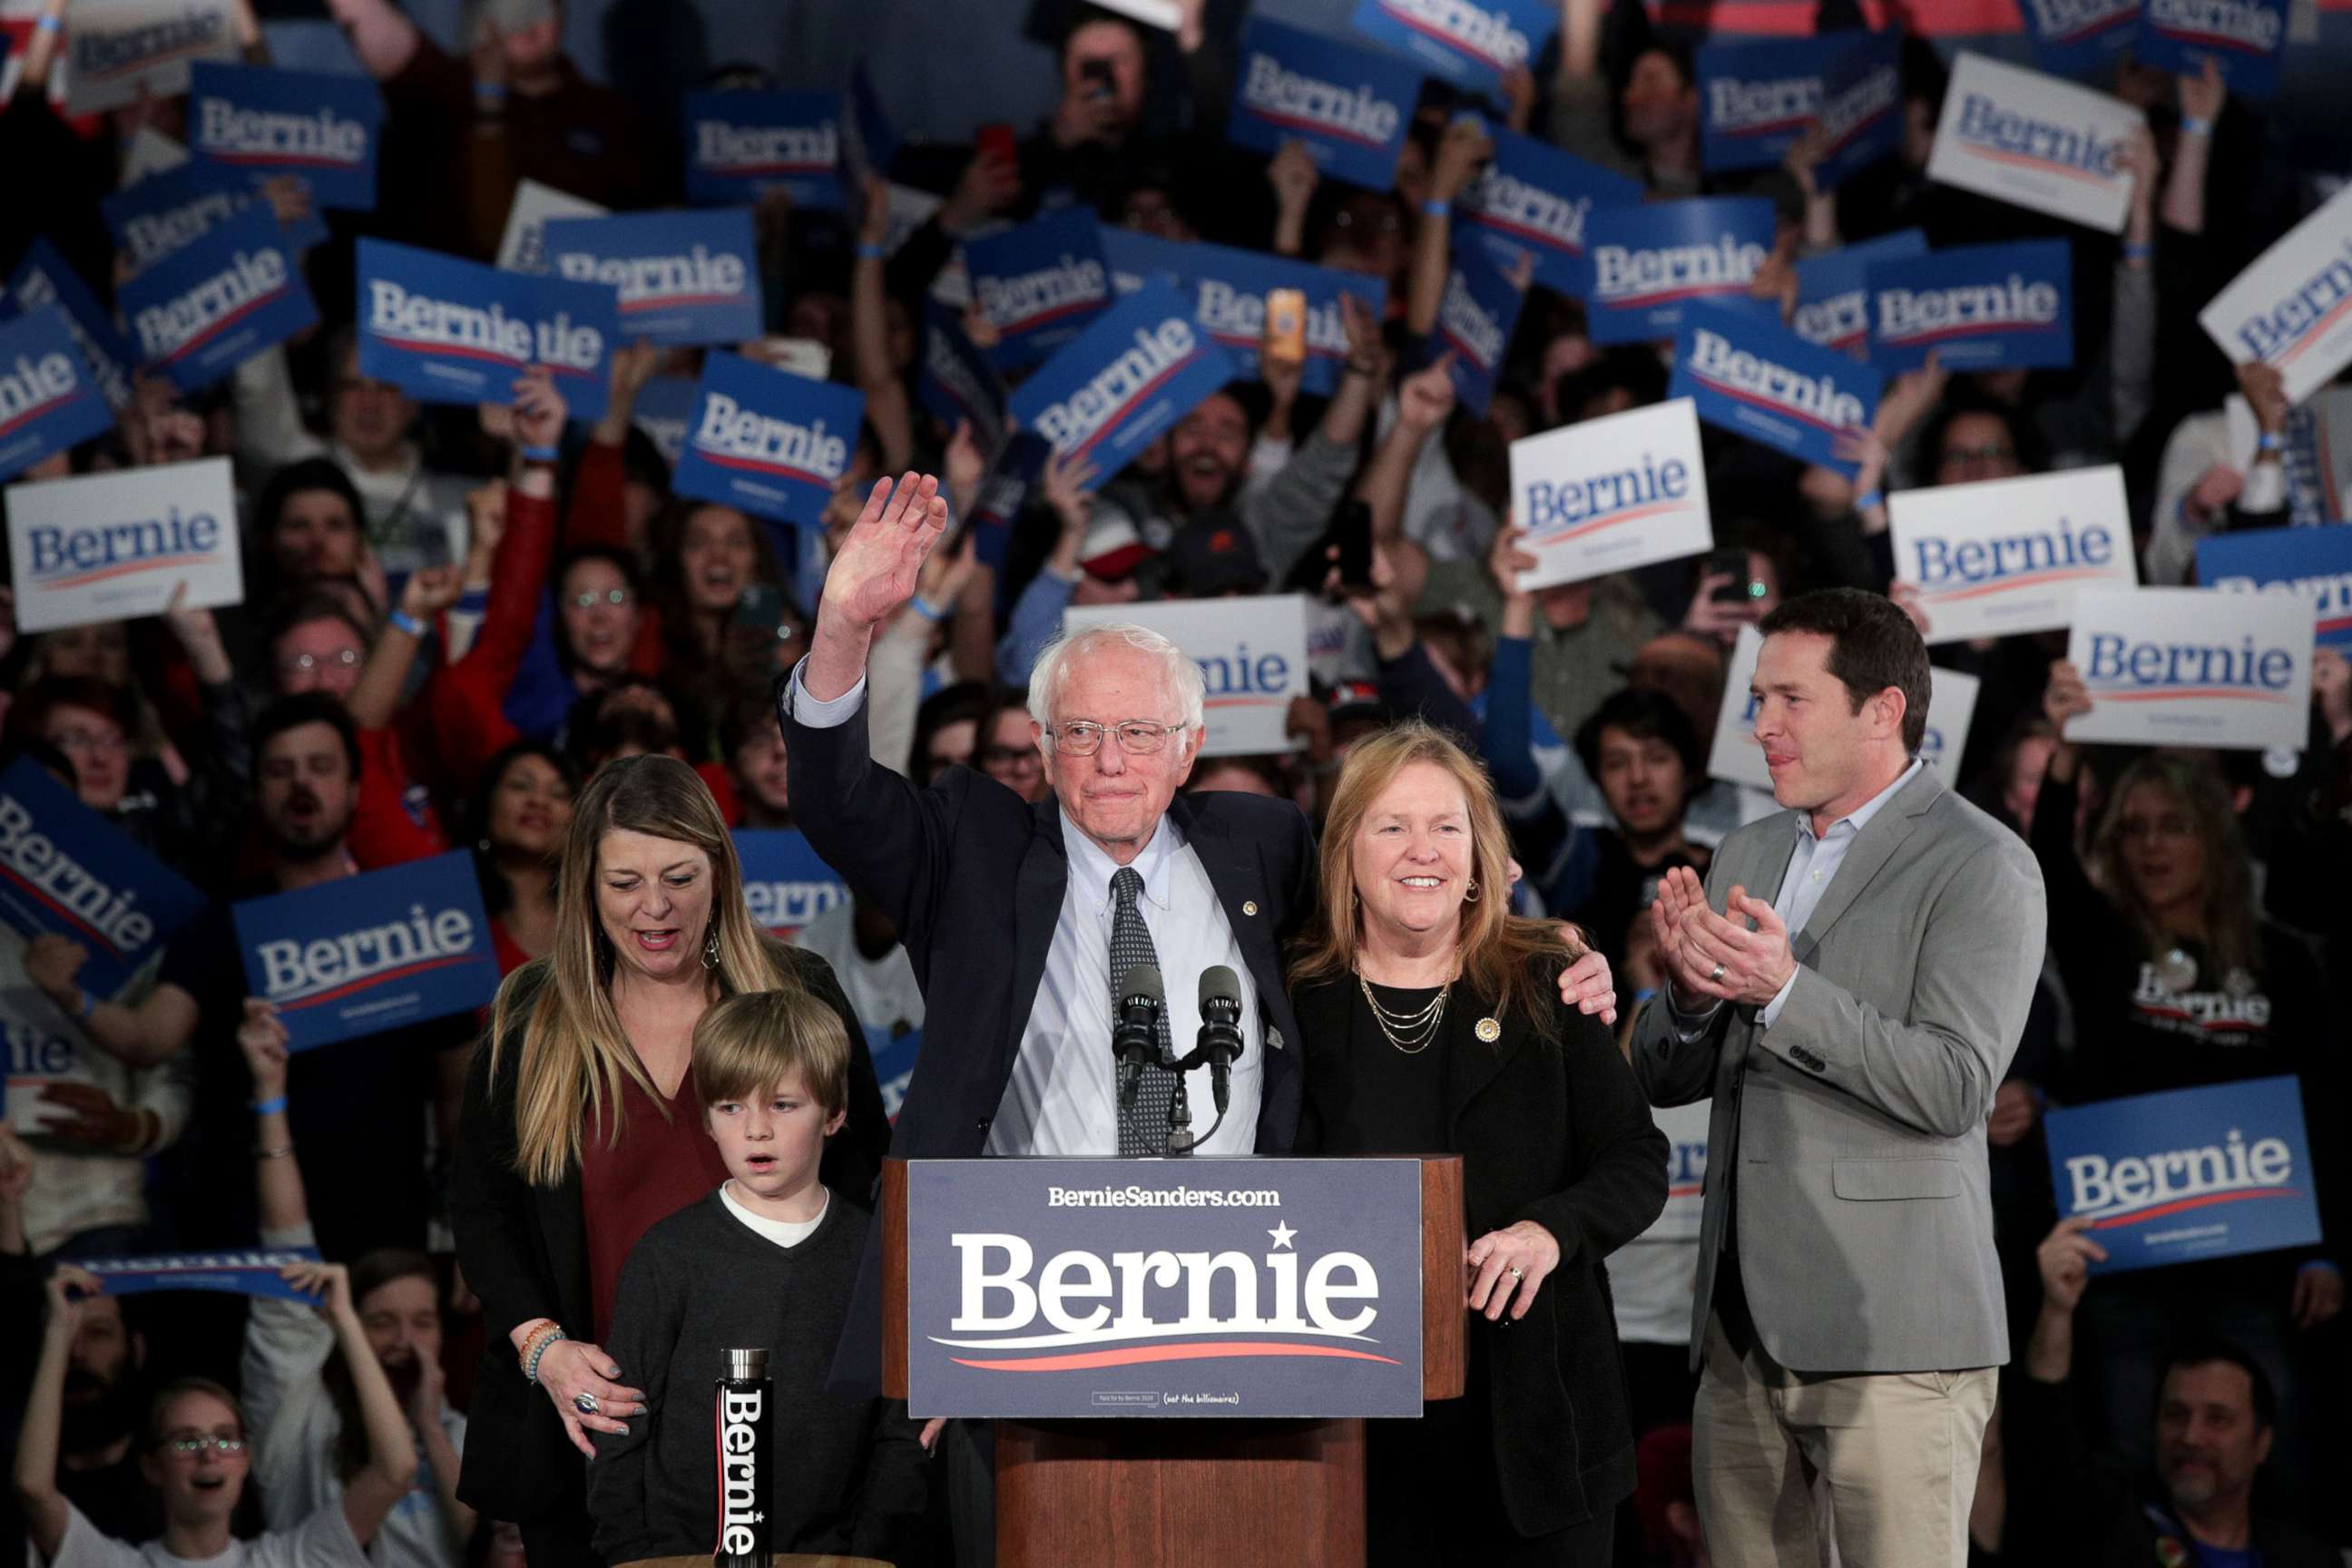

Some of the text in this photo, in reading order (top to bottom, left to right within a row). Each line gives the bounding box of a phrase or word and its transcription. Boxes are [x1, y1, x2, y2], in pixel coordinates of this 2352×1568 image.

[200, 96, 367, 162] Bernie
[1247, 51, 1399, 143] Bernie
[136, 248, 289, 359] Bernie
[369, 279, 534, 363] Bernie
[1877, 272, 2060, 336] Bernie
[2237, 240, 2352, 360] Bern
[1033, 318, 1198, 456] Bernie
[1690, 325, 1866, 428] Bernie
[694, 390, 848, 481] Bernie
[1527, 452, 1690, 526] Bernie
[28, 505, 219, 575] Bernie
[1914, 514, 2114, 583] Bernie
[2089, 632, 2295, 690] Bernie
[259, 903, 474, 996] Bernie
[1047, 1185, 1281, 1208] BernieSanders.com
[2065, 1129, 2292, 1214] Bernie
[950, 1219, 1380, 1335] Bernie
[725, 1389, 766, 1556] Bernie
